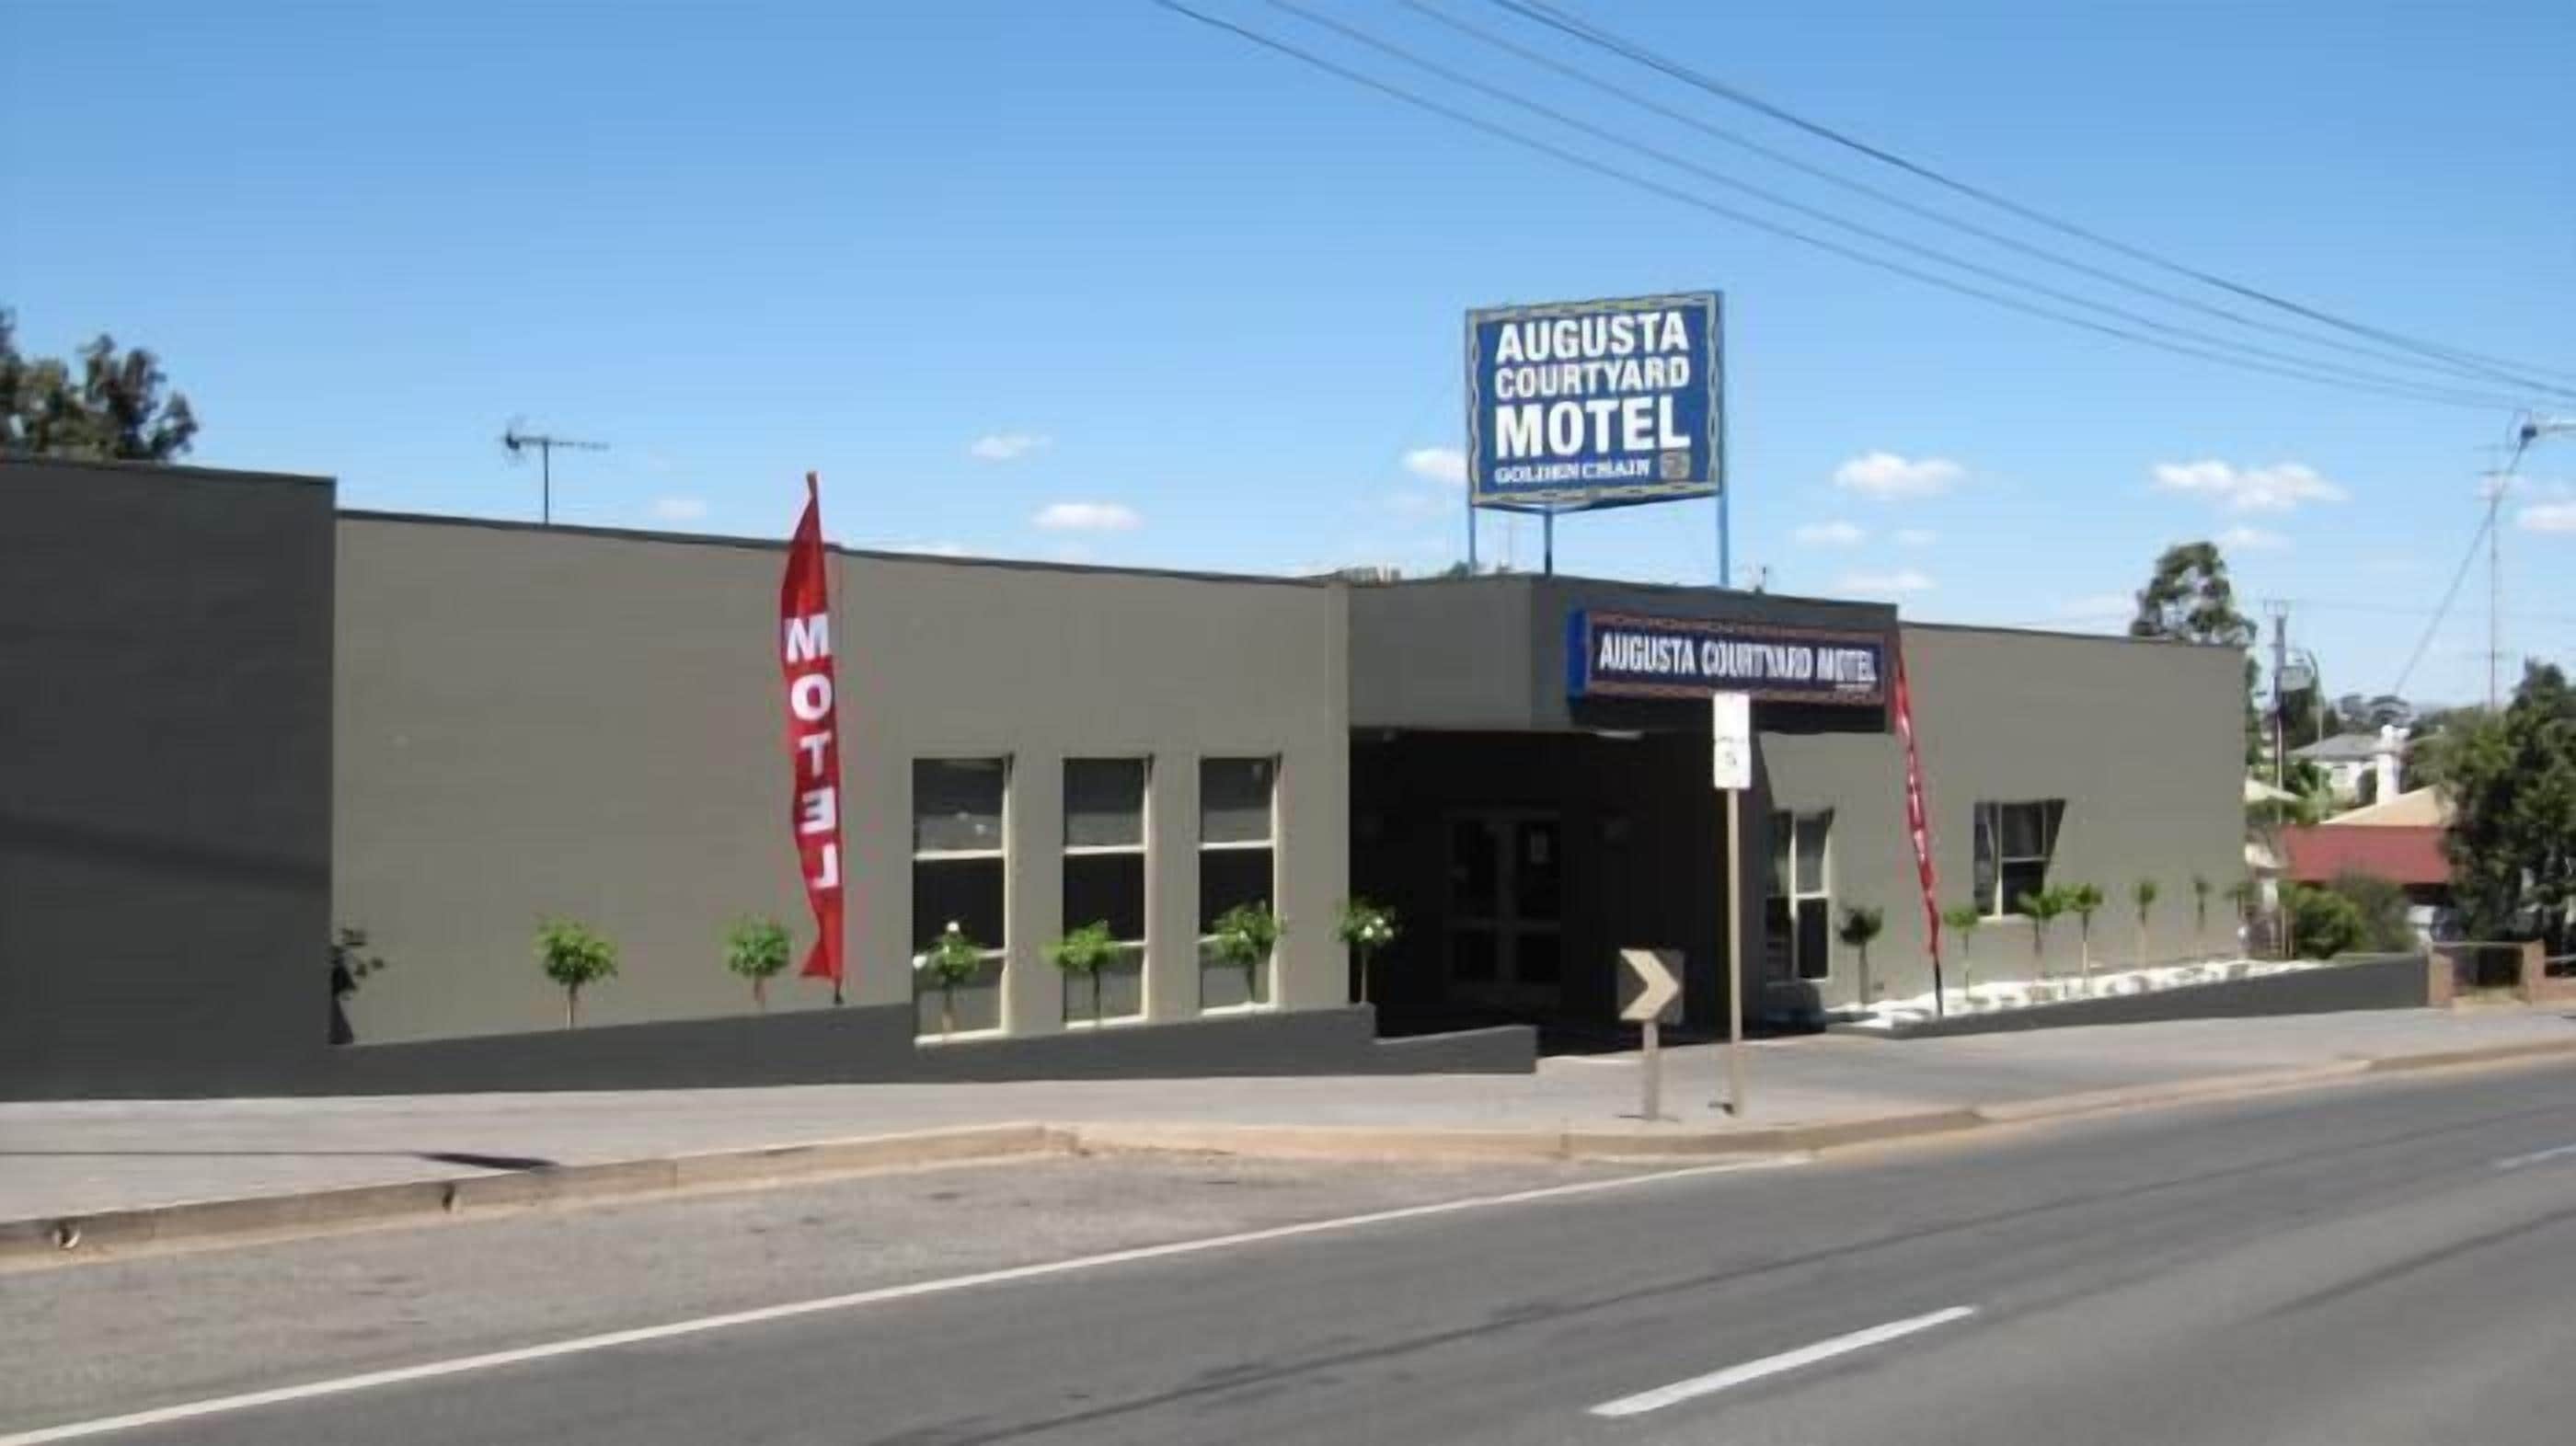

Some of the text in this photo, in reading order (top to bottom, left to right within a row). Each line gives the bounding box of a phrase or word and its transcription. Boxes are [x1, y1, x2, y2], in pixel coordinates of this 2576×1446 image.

[1495, 312, 1690, 362] AUGUSTA
[1494, 356, 1690, 399] COURTYARD
[1495, 394, 1691, 459] MOTEL
[1599, 632, 1696, 674] AUGUSTA
